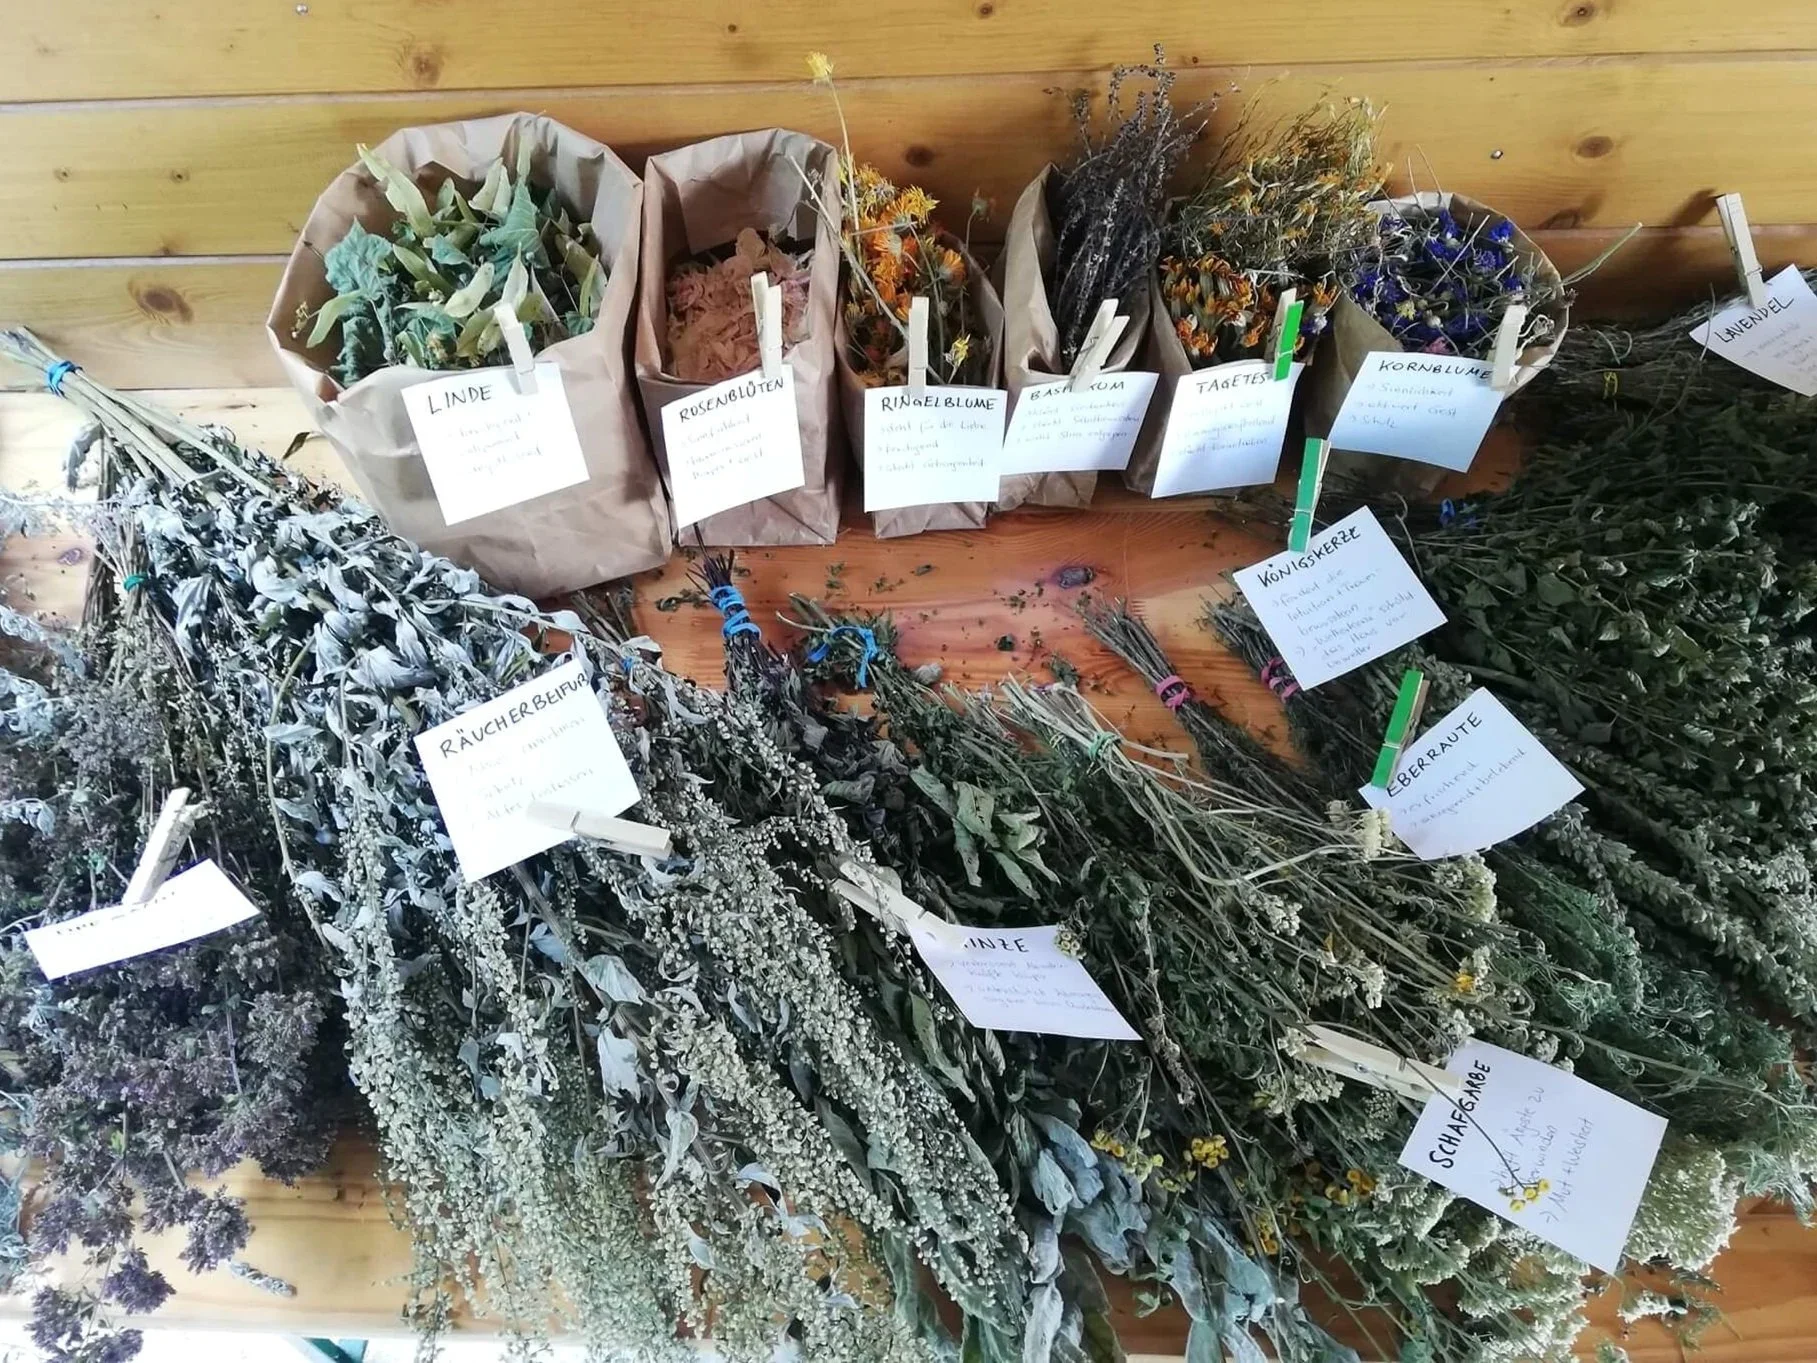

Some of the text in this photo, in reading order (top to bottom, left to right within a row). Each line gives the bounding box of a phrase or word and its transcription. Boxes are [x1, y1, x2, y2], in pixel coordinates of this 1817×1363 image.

[1714, 296, 1794, 343] LAVENDEL
[1196, 372, 1269, 394] TAGETES
[1379, 360, 1493, 379] KORNBLUME
[428, 385, 493, 415] LINDE
[679, 377, 783, 423] ROSENBLÜTEN
[881, 394, 998, 412] RINGELBLUME
[1030, 381, 1124, 401] BASIKUM
[1257, 525, 1361, 588] KÖNIGSKERZE
[1386, 711, 1482, 798] EBERRAUTE
[964, 937, 1030, 953] INZE
[1429, 1059, 1491, 1169] SCHAFGARBE
